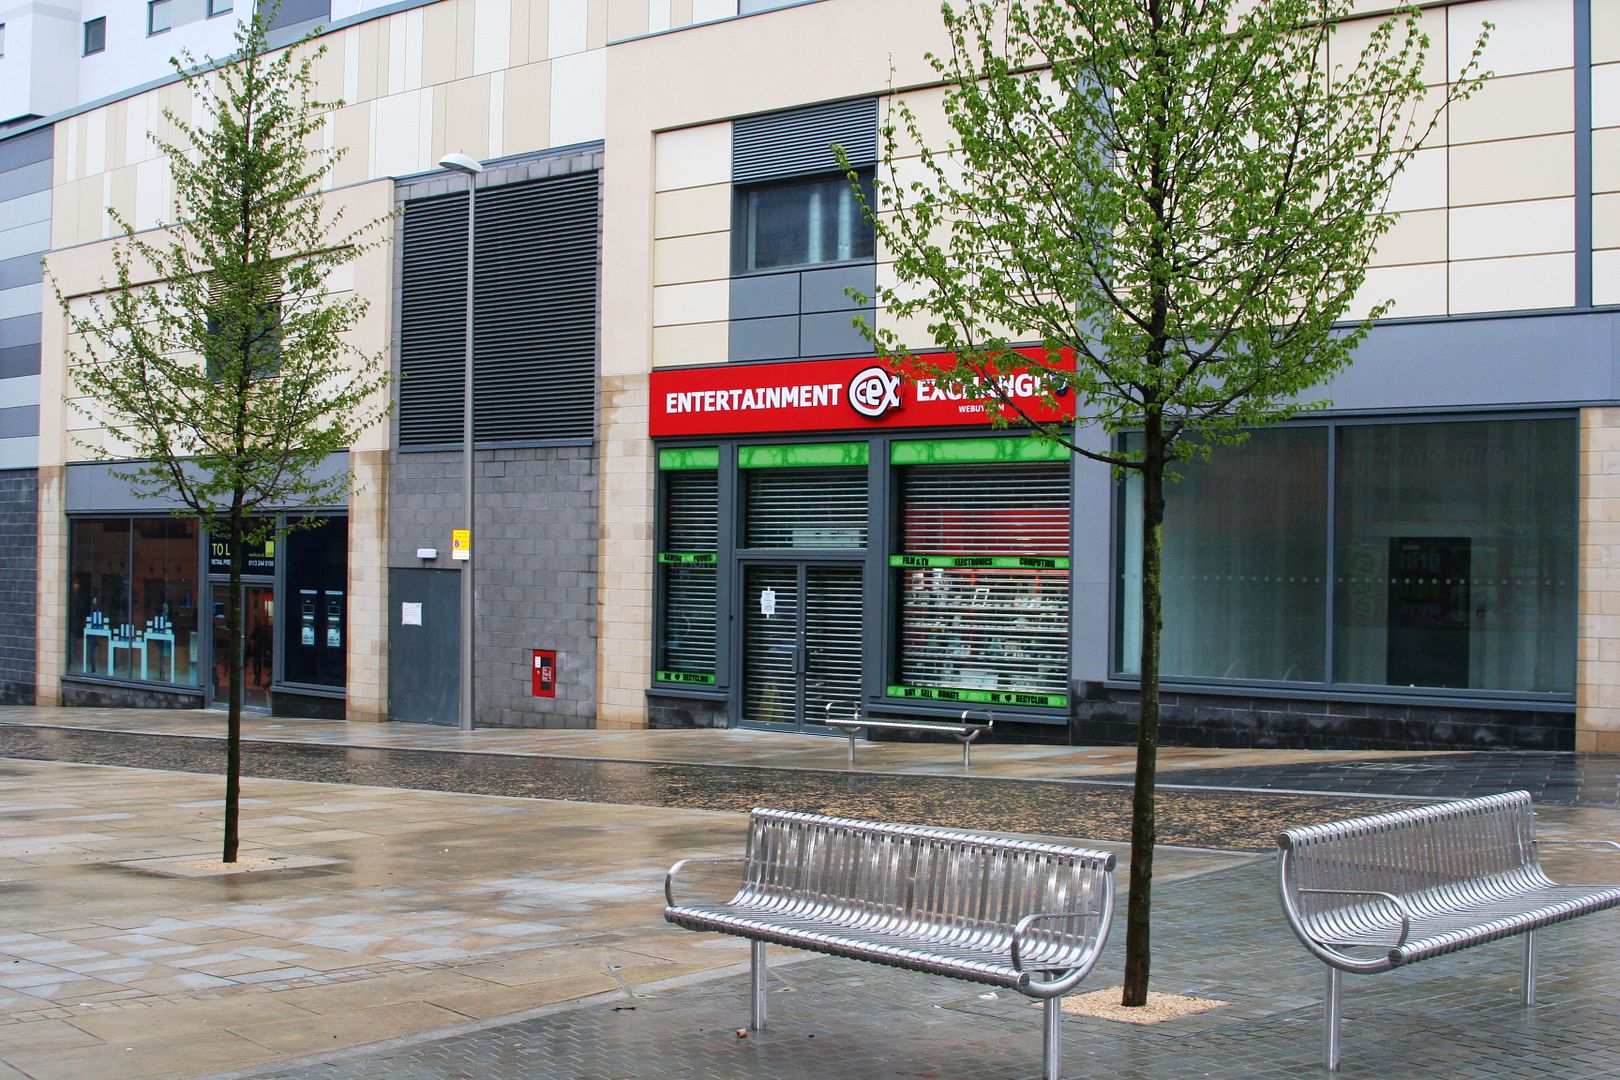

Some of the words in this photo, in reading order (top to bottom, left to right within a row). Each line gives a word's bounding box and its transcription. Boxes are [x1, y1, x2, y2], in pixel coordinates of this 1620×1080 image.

[666, 383, 843, 414] ENTERTAINMENT
[958, 403, 1005, 413] WEBUY.M
[212, 543, 224, 556] TO
[902, 556, 916, 565] FILM
[920, 558, 929, 566] TV
[954, 558, 993, 566] ELECTRONICS
[1019, 557, 1056, 568] COMPUTING
[920, 688, 933, 698] SELL
[937, 689, 960, 700] DONATE
[991, 693, 1001, 702] WE
[1015, 694, 1049, 706] RECYCLING
